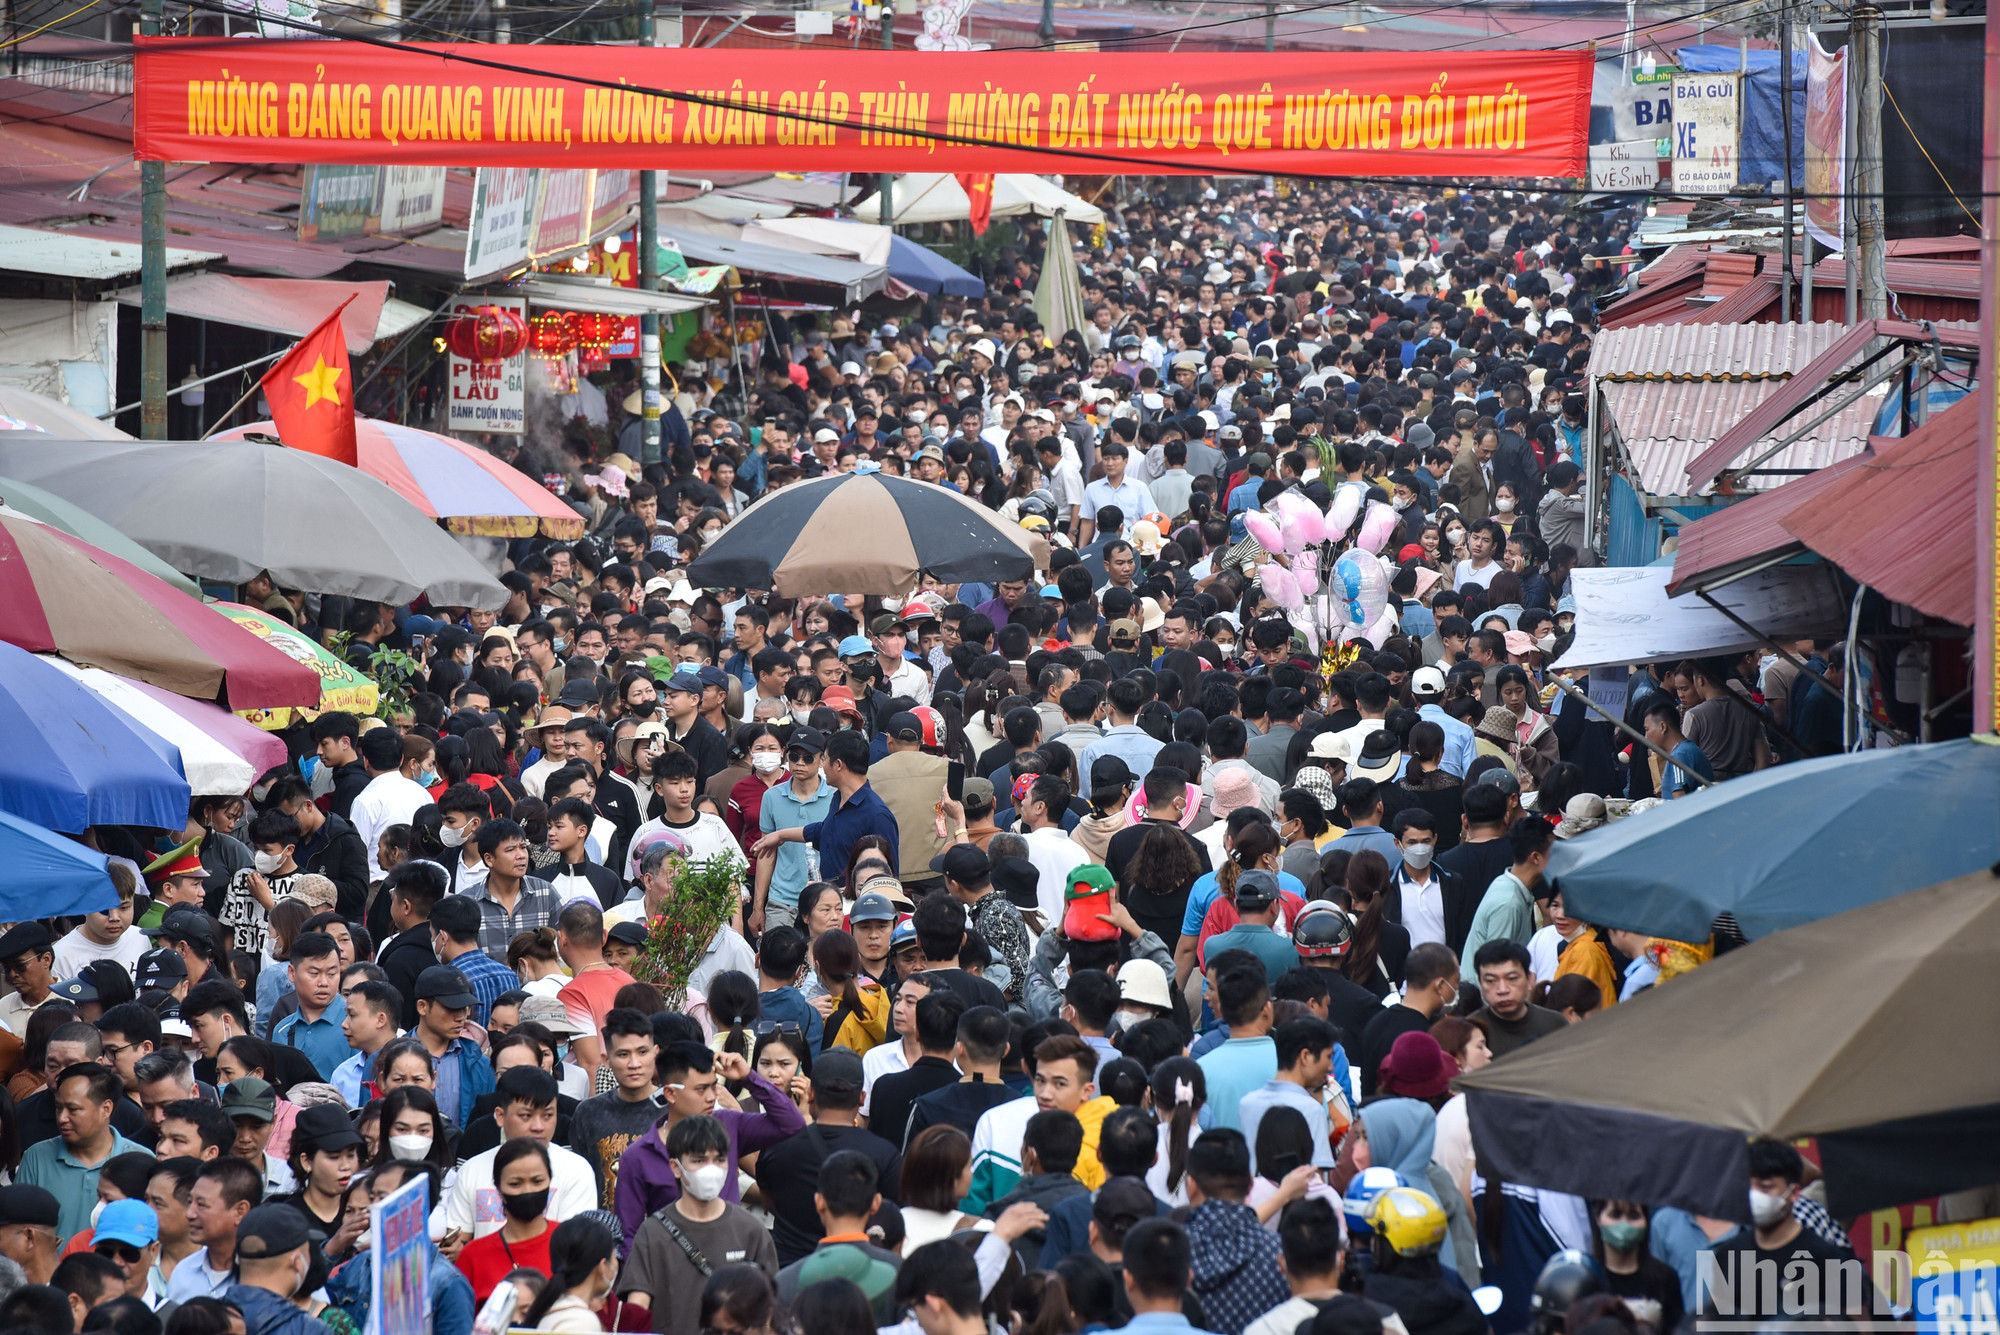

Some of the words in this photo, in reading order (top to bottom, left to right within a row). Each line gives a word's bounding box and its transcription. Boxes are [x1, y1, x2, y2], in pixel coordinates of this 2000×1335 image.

[1677, 79, 1702, 99] BÃI
[1706, 78, 1733, 98] GỬI
[187, 69, 278, 138] MỪNG
[287, 64, 372, 140] ĐẢNG
[381, 84, 483, 147] QUANG
[493, 87, 571, 150] VINH,
[582, 76, 675, 145] MỪNG
[682, 79, 769, 146] XUÂN
[776, 79, 849, 147] GIÁP
[859, 81, 937, 155] THÌN,
[946, 81, 1041, 149] MỪNG
[1048, 74, 1110, 149] ĐẤT
[1116, 82, 1203, 150] NƯỚC
[1212, 82, 1275, 156] QUÊ
[1282, 89, 1391, 151] HƯƠNG
[1400, 72, 1456, 150] ĐỔI
[1464, 82, 1529, 150] MỚI
[1676, 121, 1697, 158] XE
[451, 403, 474, 419] BÁNH
[475, 403, 498, 420] CUỐN
[500, 405, 523, 421] NÓNG
